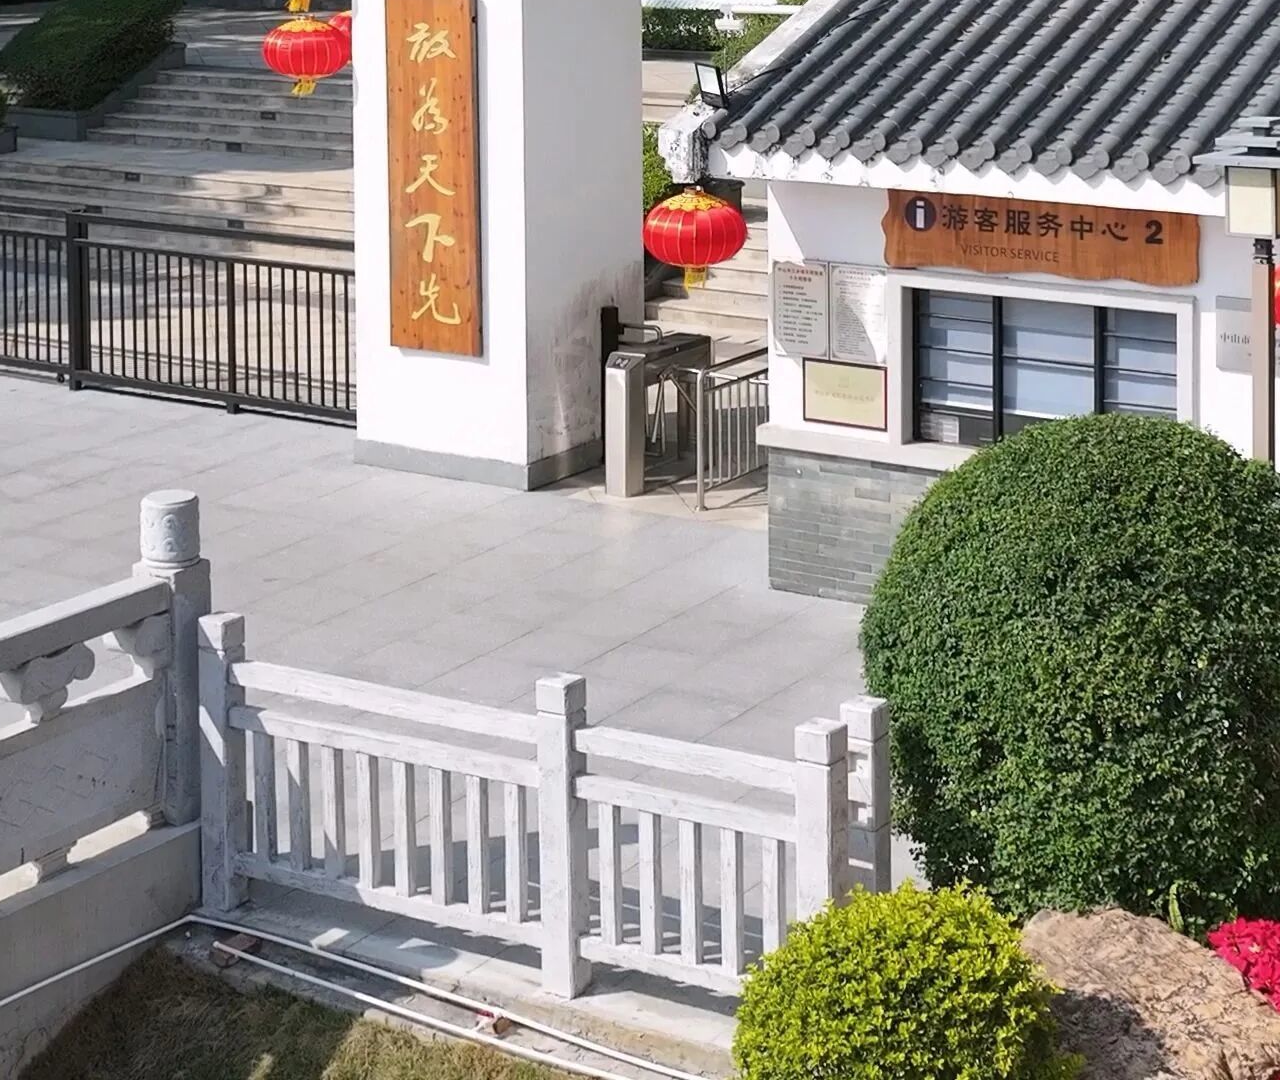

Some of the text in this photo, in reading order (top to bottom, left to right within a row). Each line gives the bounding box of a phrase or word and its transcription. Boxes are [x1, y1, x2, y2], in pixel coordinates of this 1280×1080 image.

[941, 203, 1164, 245] 游客服务中心 2
[960, 243, 1060, 263] VISITOR SERVICE
